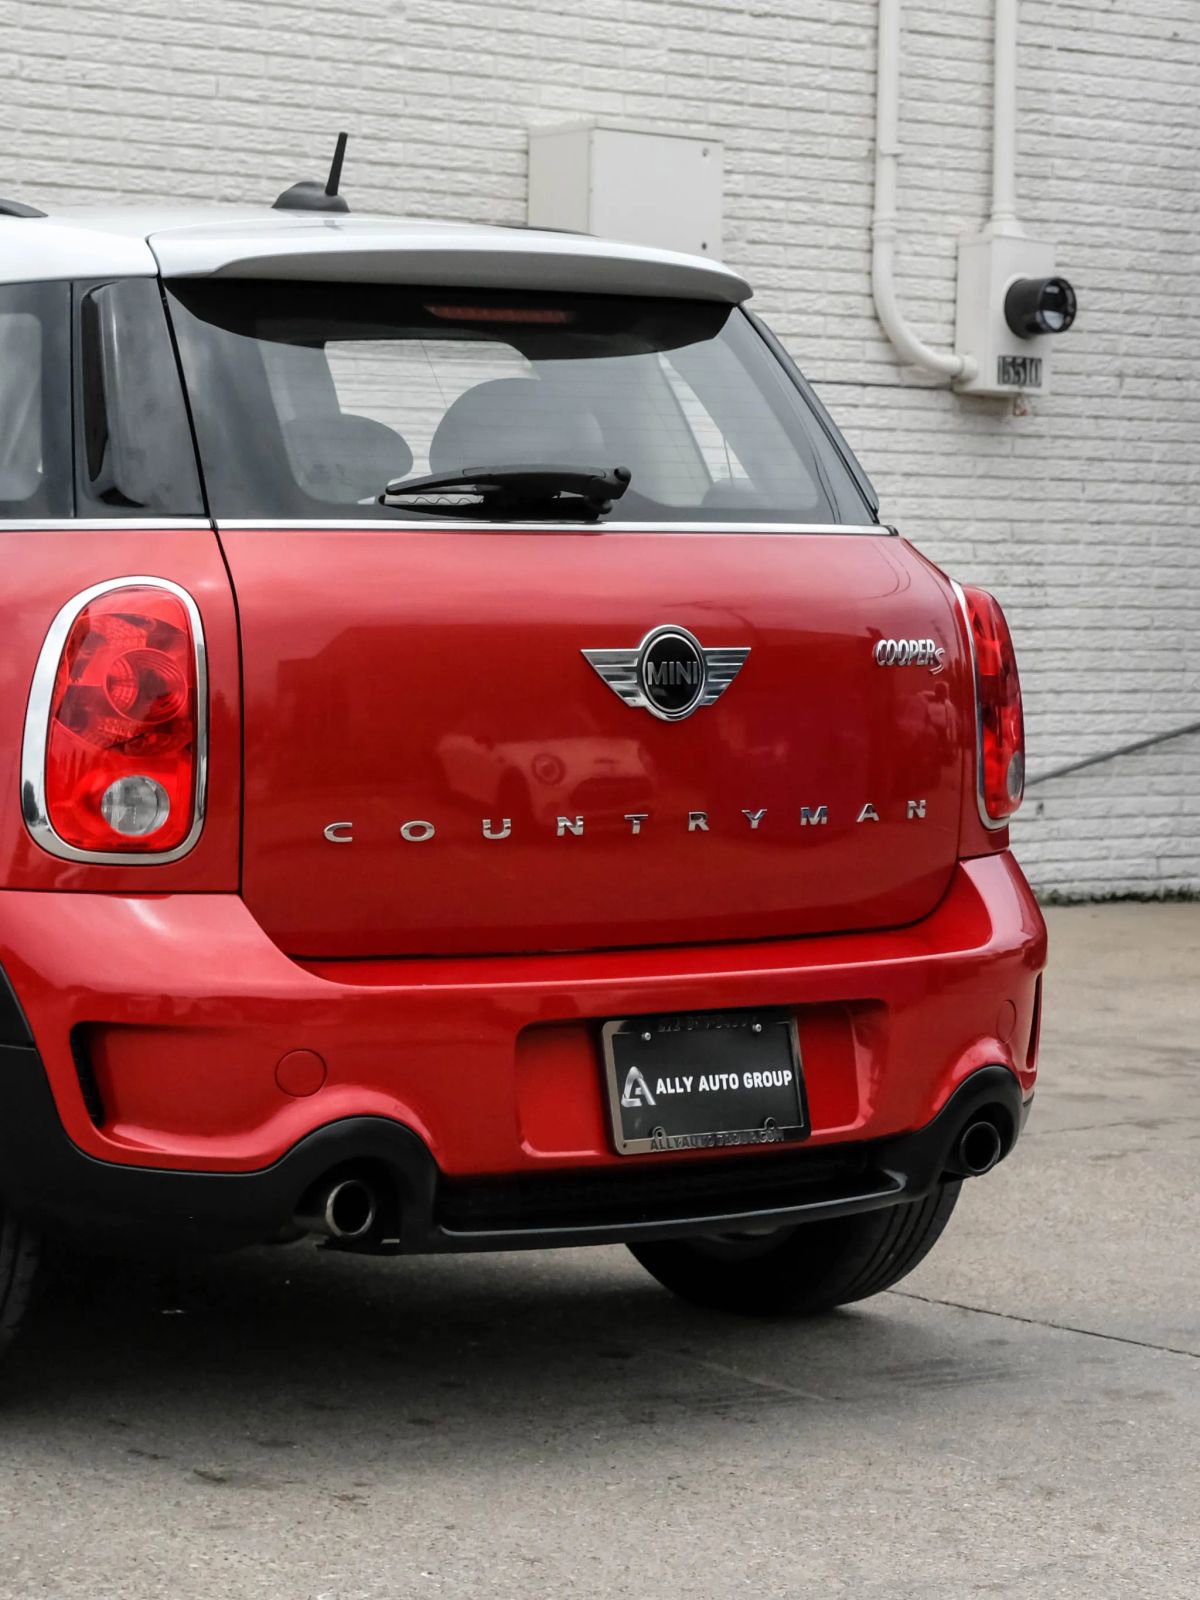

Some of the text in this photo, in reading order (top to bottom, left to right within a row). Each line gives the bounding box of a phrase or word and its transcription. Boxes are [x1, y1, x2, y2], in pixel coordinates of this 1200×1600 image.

[647, 661, 698, 685] MINI
[323, 799, 927, 843] COUNTRYMAN
[656, 1070, 793, 1095] ALLY AUTO GROUP
